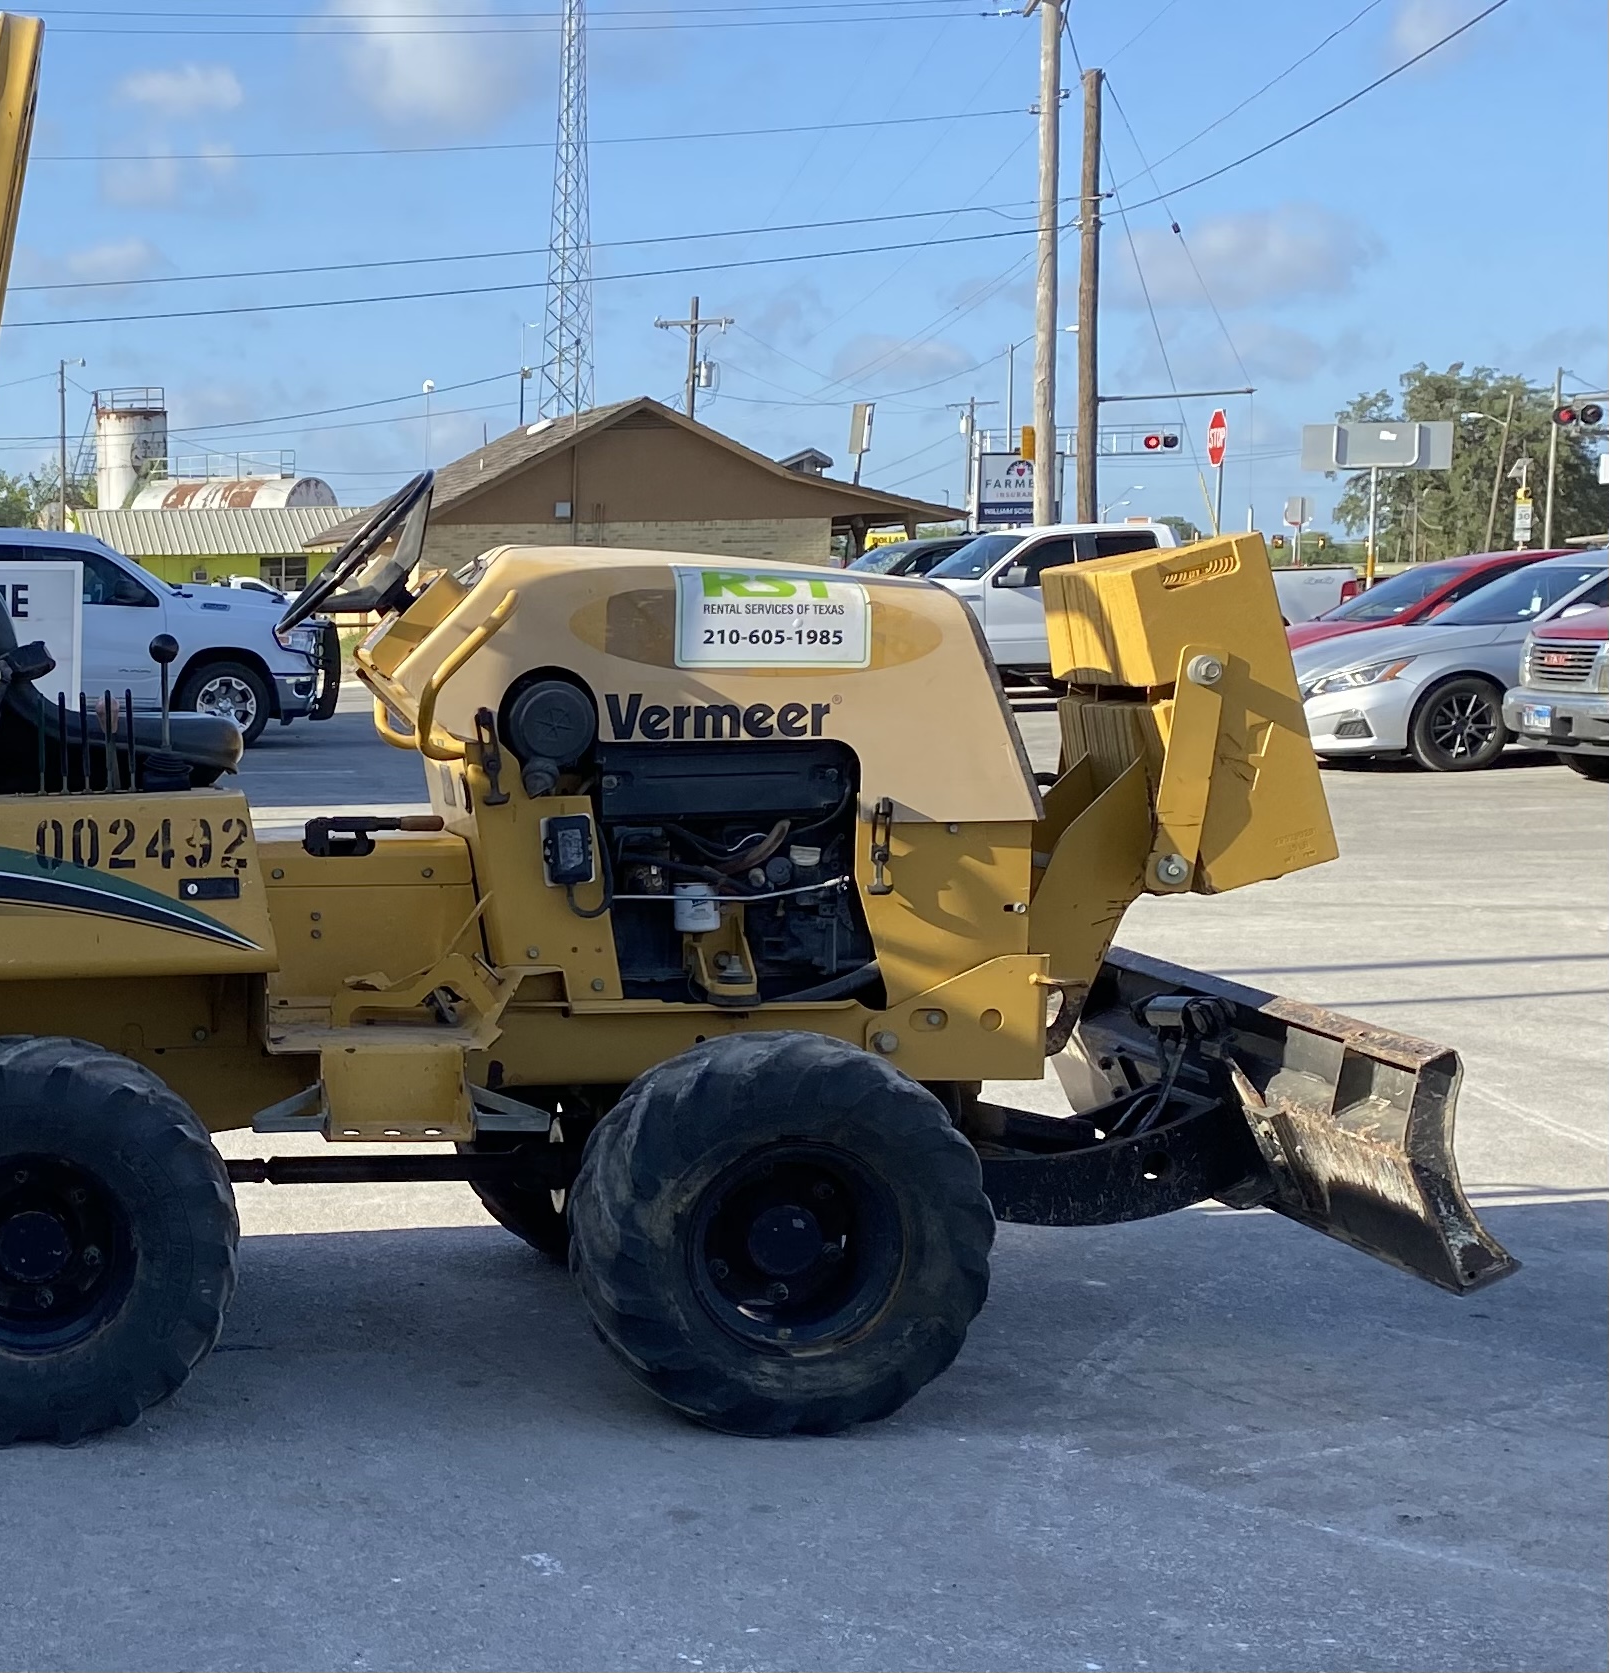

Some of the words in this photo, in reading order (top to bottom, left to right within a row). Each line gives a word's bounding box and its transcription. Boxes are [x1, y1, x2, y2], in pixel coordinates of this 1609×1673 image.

[1209, 427, 1226, 449] STOP
[872, 536, 906, 544] DOLLAR
[703, 604, 742, 615] RENTAL
[745, 604, 794, 615] SERVICES
[797, 604, 810, 615] OF
[813, 604, 845, 615] TEXAS
[703, 629, 844, 645] 210-605-1985
[604, 693, 831, 740] Vermeer
[36, 817, 249, 870] 002492
